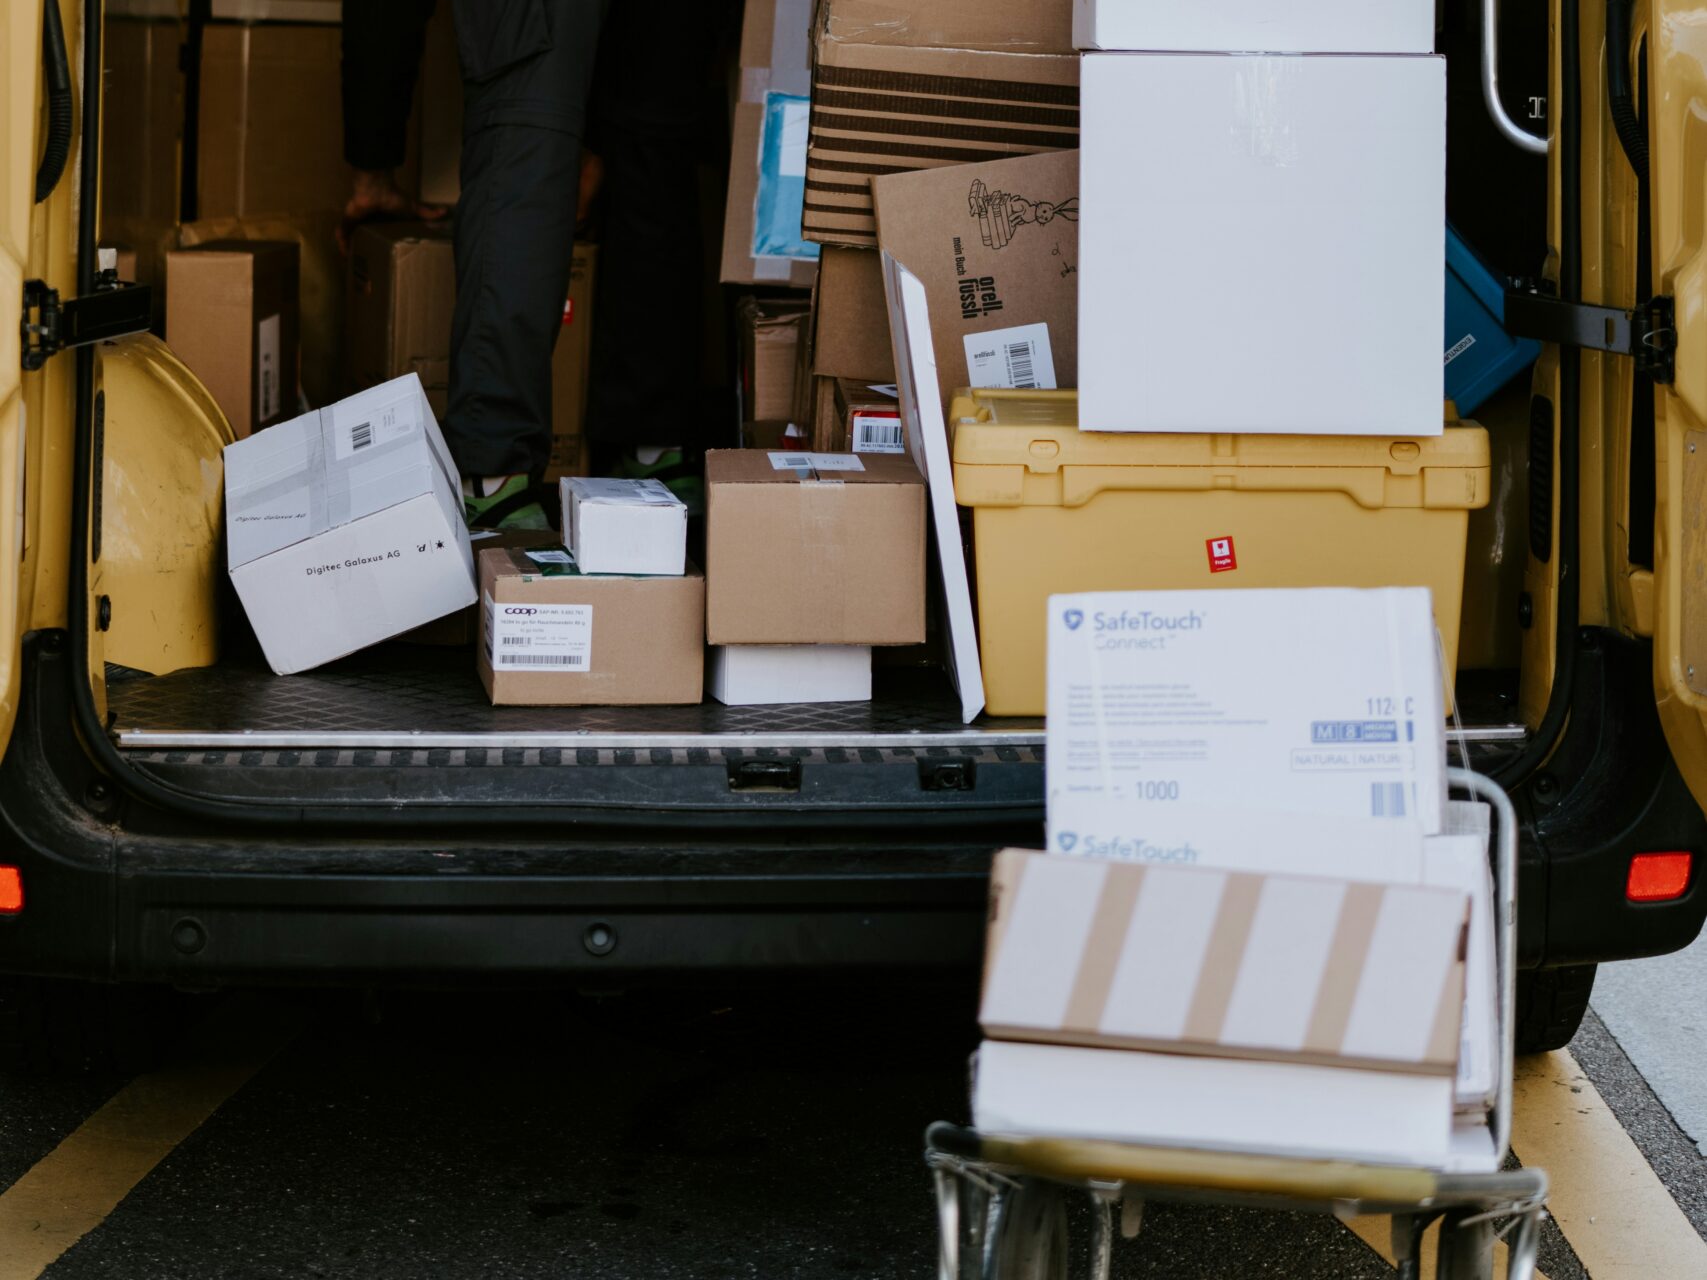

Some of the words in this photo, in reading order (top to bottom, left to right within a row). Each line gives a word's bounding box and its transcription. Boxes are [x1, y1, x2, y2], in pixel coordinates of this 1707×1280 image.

[952, 236, 963, 256] mein
[956, 256, 967, 276] Buch
[958, 279, 979, 320] füssli
[978, 276, 1003, 317] orell.
[234, 513, 261, 523] Digitec
[306, 562, 342, 576] Digitec
[344, 554, 384, 568] Galaxus
[386, 549, 401, 559] AG
[505, 607, 538, 616] coop
[1093, 609, 1202, 631] SafeTouch
[1095, 634, 1166, 651] Connect
[1317, 724, 1333, 739] M
[1345, 724, 1357, 739] 8
[1294, 752, 1350, 765] NATURAL
[1135, 780, 1180, 801] 1000
